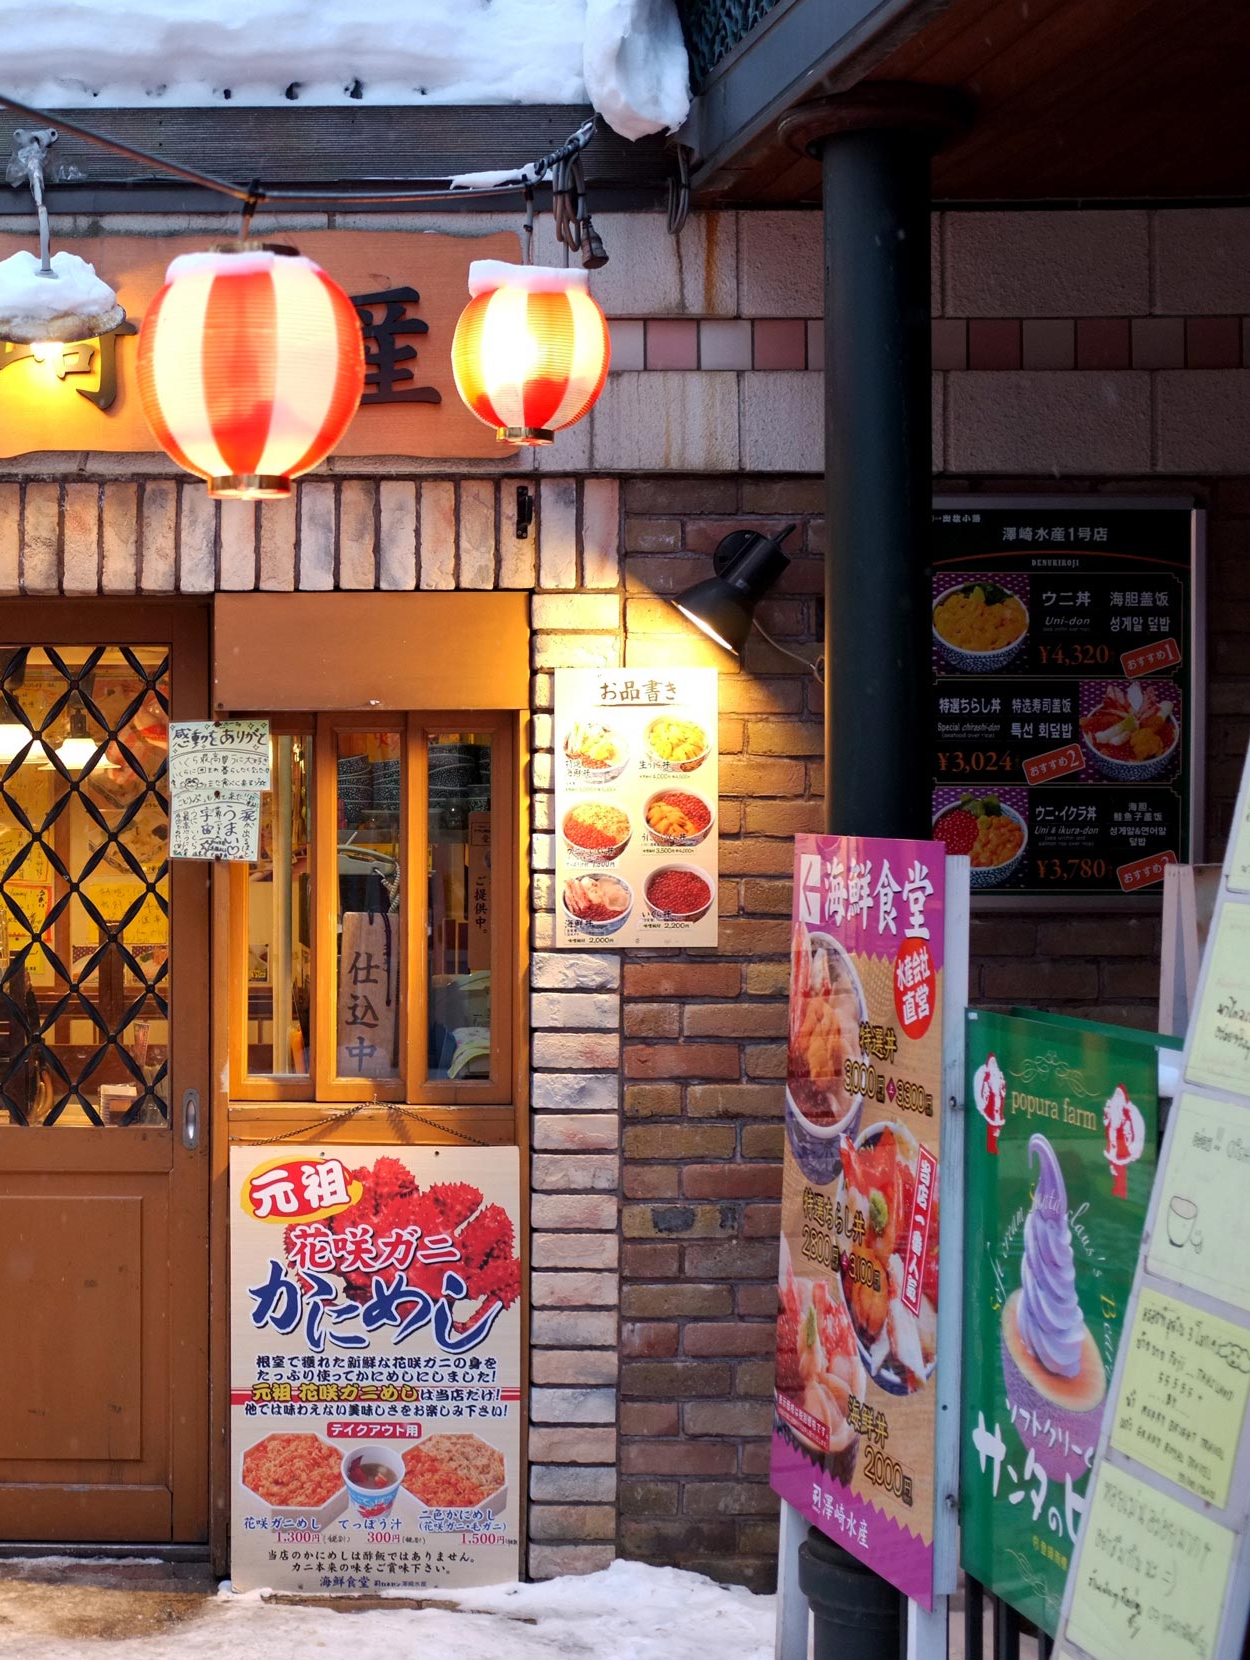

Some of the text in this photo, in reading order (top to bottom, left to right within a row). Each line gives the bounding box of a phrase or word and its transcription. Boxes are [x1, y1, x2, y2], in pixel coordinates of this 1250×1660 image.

[1002, 526, 1109, 543] 澤崎水産1号店
[1031, 559, 1080, 568] DENUKIKOJI
[1042, 591, 1092, 607] ウニ丼
[1109, 591, 1169, 607] 海胆盖饭
[1044, 616, 1091, 626] Uni-don
[1039, 643, 1110, 667] ¥4,320
[600, 680, 678, 702] お品書き
[938, 697, 1002, 714] 特選ちらし丼
[937, 751, 1014, 775] ¥3,024
[1034, 826, 1049, 836] Uni
[1037, 858, 1106, 881] ¥3,780
[824, 854, 934, 941] 海鮮食堂
[344, 951, 379, 1073] 仕込中
[902, 983, 931, 1026] 直営
[1011, 1090, 1097, 1131] popura farm
[250, 1158, 352, 1218] 元祖
[290, 1225, 462, 1273] 花咲ガニ
[248, 1259, 502, 1354] かにめし
[256, 1355, 497, 1370] 根室で獲れた新鮮な花咲ガニの身を
[256, 1369, 496, 1384] たっぷり使ってかにめしにしました!
[331, 1424, 419, 1437] テイクアウト用
[419, 1508, 496, 1522] 二色かにめし
[243, 1516, 321, 1531] 花咲ガニめし
[338, 1517, 403, 1531] てっぽう汁
[367, 1531, 400, 1545] 300円
[268, 1551, 476, 1563] 当店のかにめしは酢飯ではありません。
[291, 1563, 451, 1576] カニ本来の味をご賞味下さい。
[320, 1575, 370, 1589] 海鮮食堂
